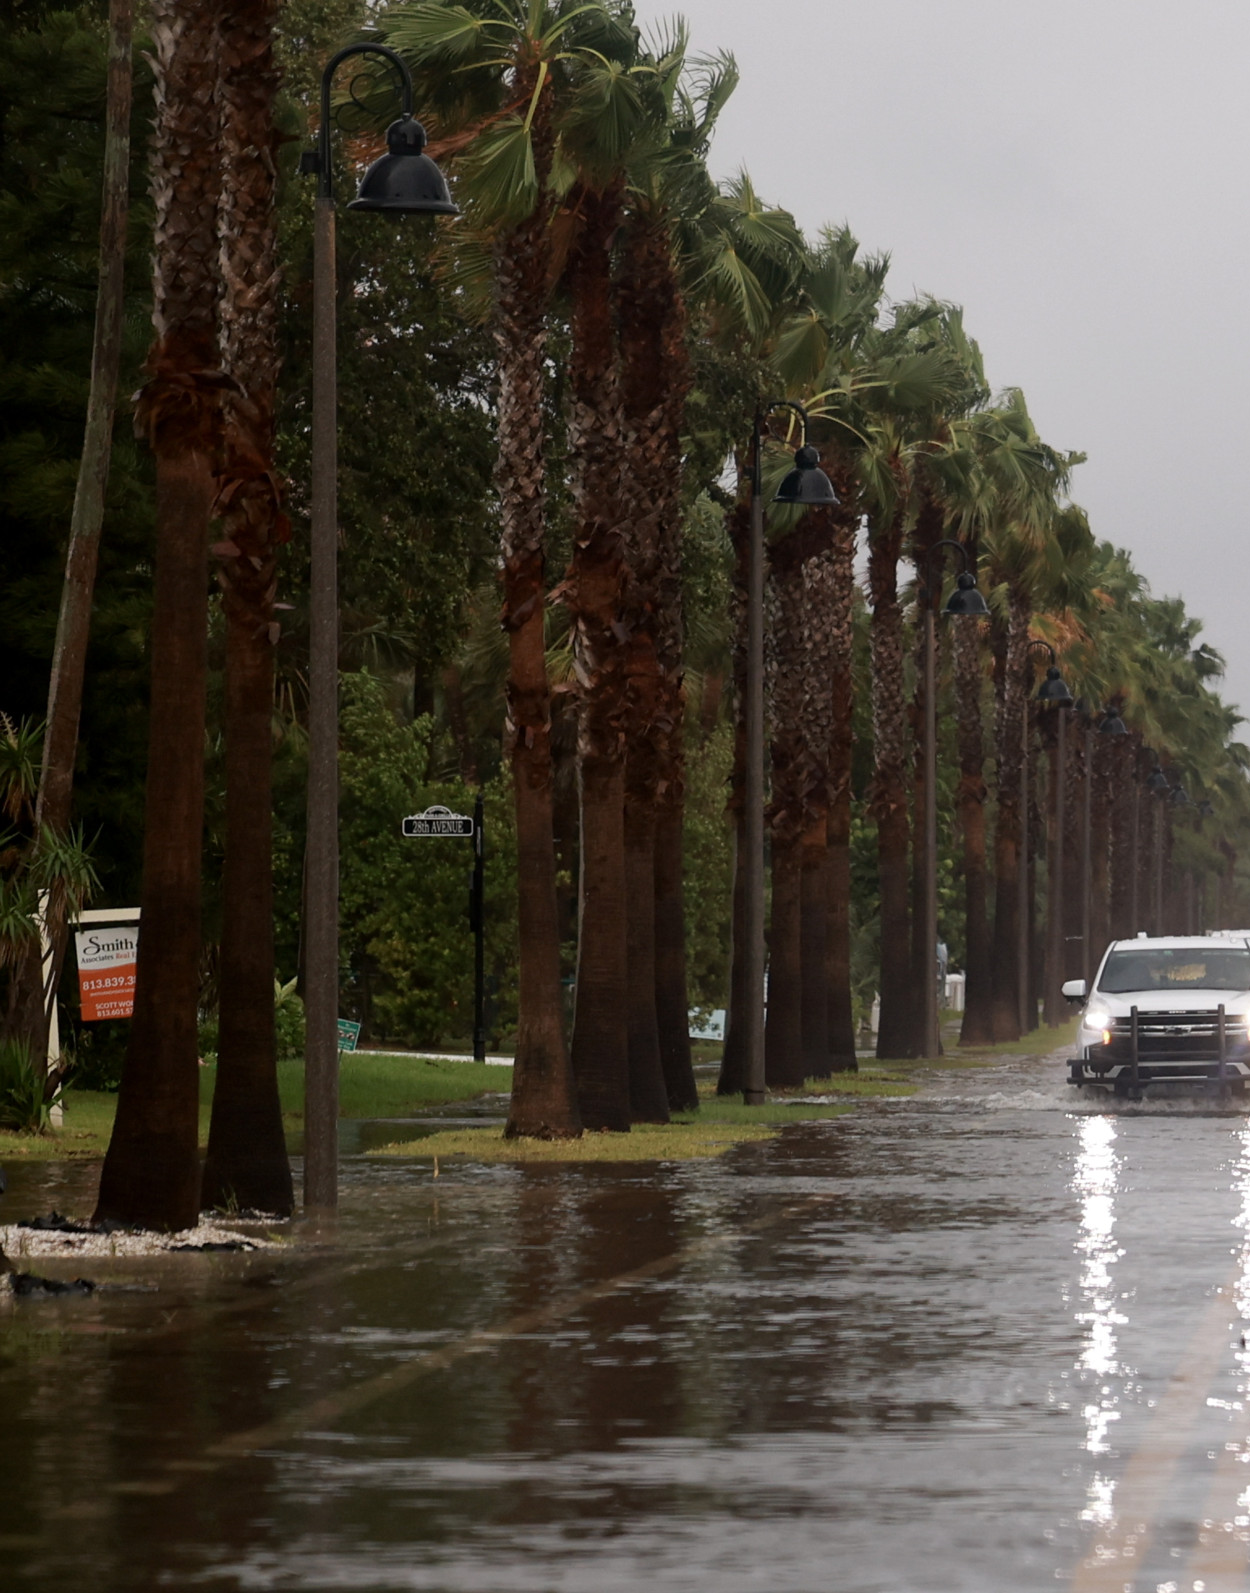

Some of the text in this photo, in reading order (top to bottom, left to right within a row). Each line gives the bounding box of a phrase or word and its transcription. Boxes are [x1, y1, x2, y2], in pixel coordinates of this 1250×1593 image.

[412, 820, 464, 833] 28th AVENUE
[83, 936, 133, 955] Smith
[81, 955, 114, 964] Associates
